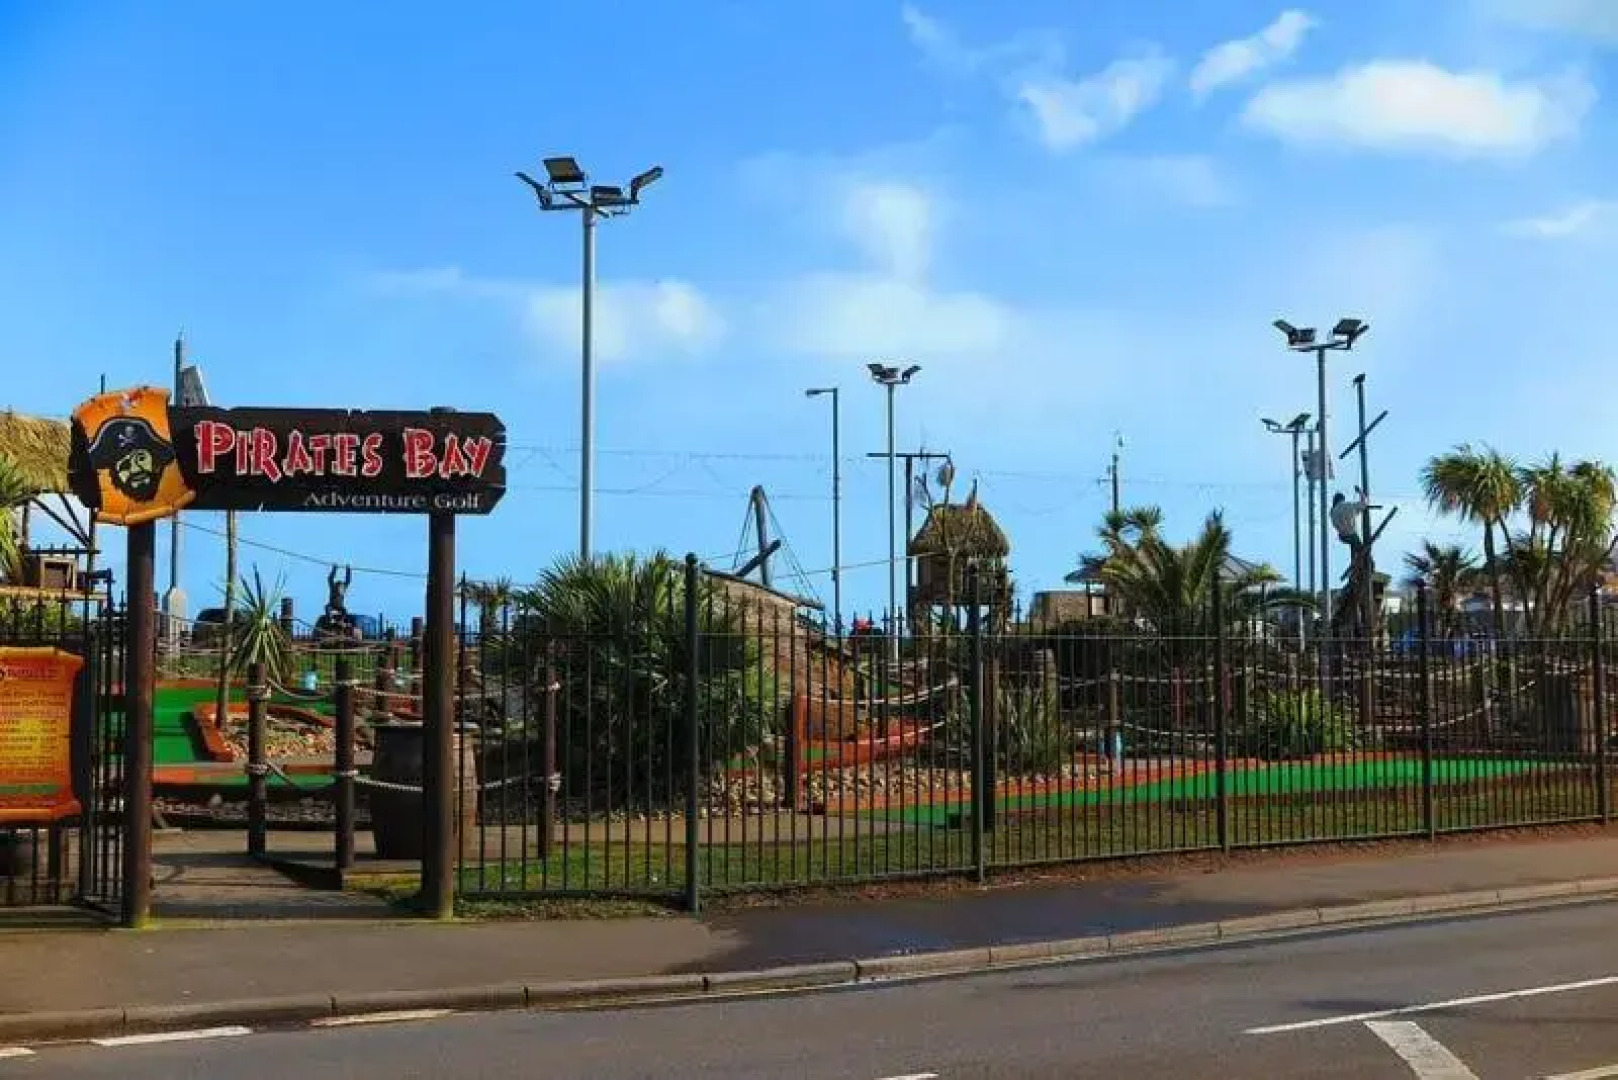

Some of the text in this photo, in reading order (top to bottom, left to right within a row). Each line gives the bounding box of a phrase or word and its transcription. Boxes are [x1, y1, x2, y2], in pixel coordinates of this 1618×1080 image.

[194, 420, 492, 483] PIRATES BAY
[303, 492, 483, 509] Adventure Golf
